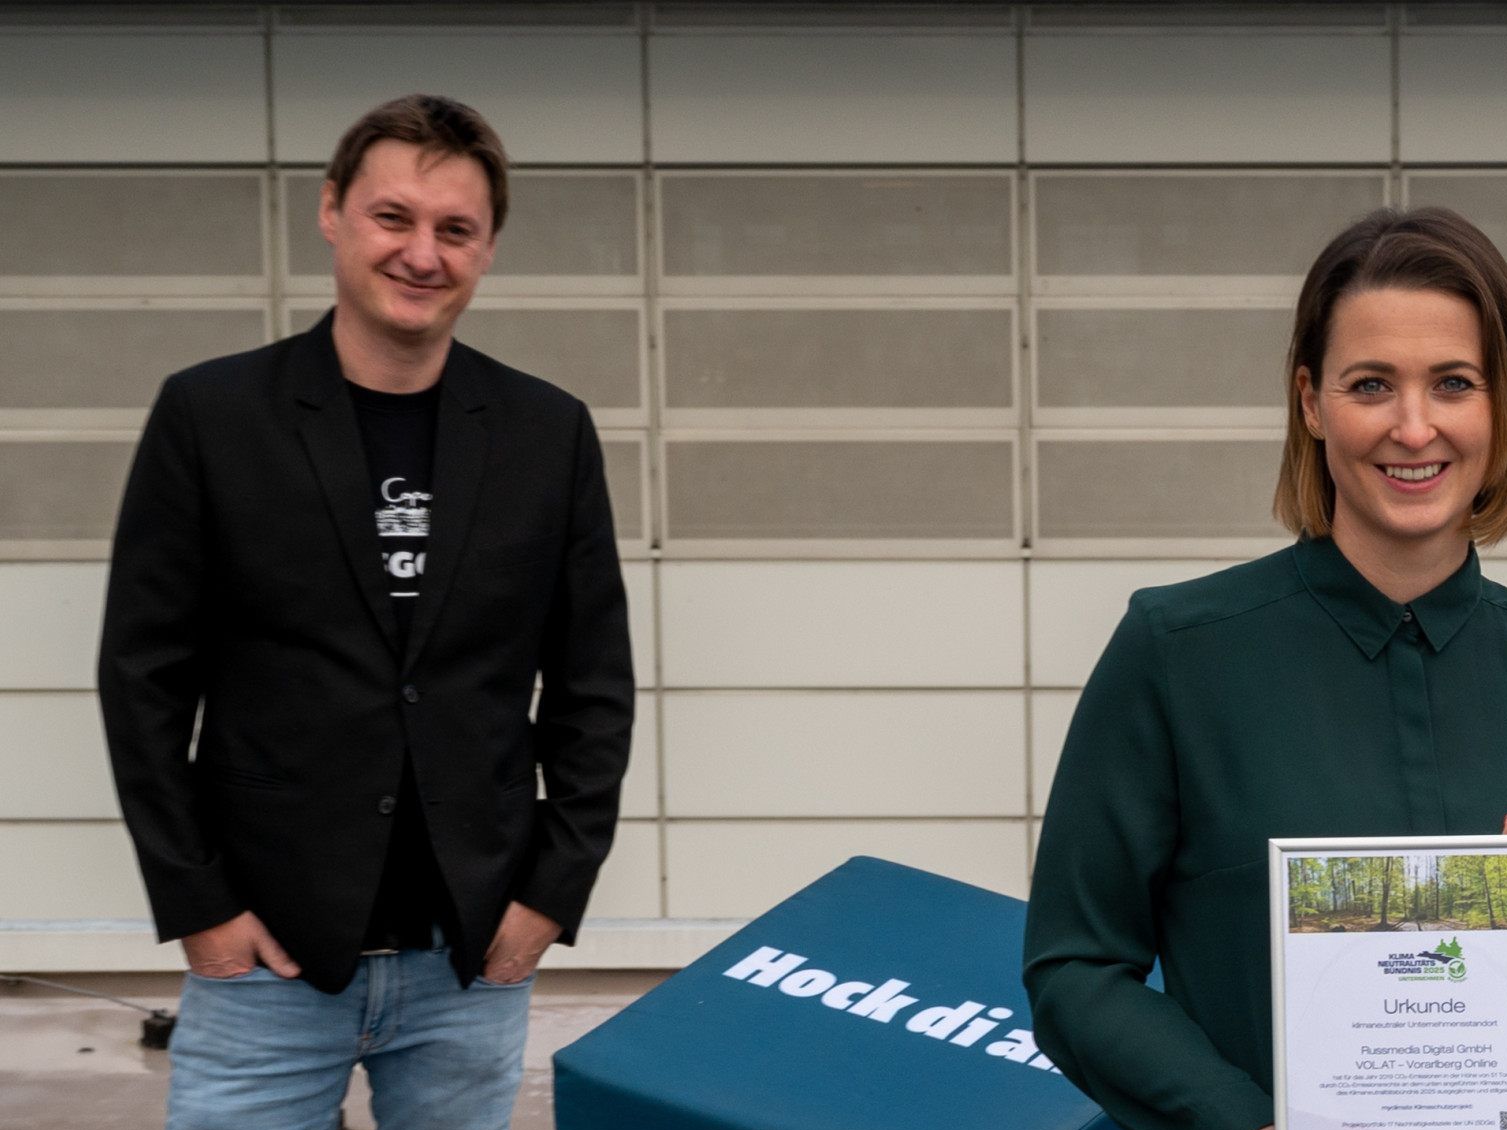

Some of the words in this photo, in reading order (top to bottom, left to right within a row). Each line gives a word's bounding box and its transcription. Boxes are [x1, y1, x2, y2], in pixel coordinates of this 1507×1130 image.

[1423, 966, 1445, 974] 2025
[723, 946, 918, 1023] Hock
[906, 1000, 1014, 1048] di
[1383, 998, 1466, 1015] Urkunde
[1360, 1046, 1420, 1055] Russmedia
[1422, 1044, 1455, 1056] Digital
[1456, 1044, 1493, 1054] GmbH
[1355, 1060, 1396, 1070] VOL.AT
[1406, 1059, 1462, 1071] Vorarlberg
[1463, 1058, 1498, 1068] Online
